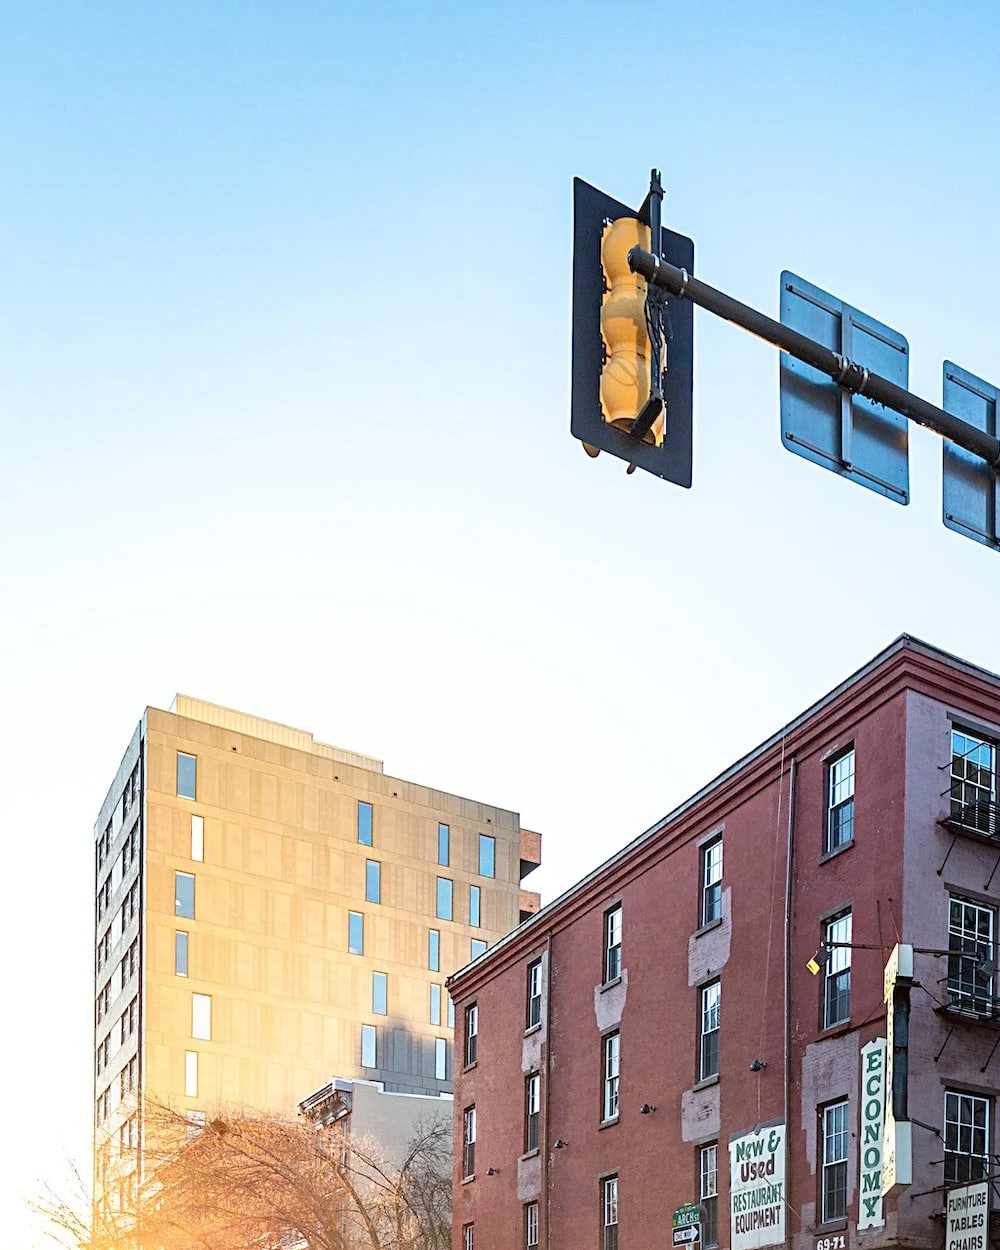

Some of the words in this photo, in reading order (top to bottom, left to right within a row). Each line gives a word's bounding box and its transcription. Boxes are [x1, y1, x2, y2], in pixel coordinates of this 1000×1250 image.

[863, 1048, 882, 1218] ECONOMY
[736, 1139, 764, 1162] New
[740, 1153, 775, 1182] Used
[733, 1182, 783, 1214] RESTAURANT
[948, 1192, 987, 1213] FURNITURE
[735, 1205, 781, 1234] EQUIPMENT
[950, 1213, 984, 1233] TABLES
